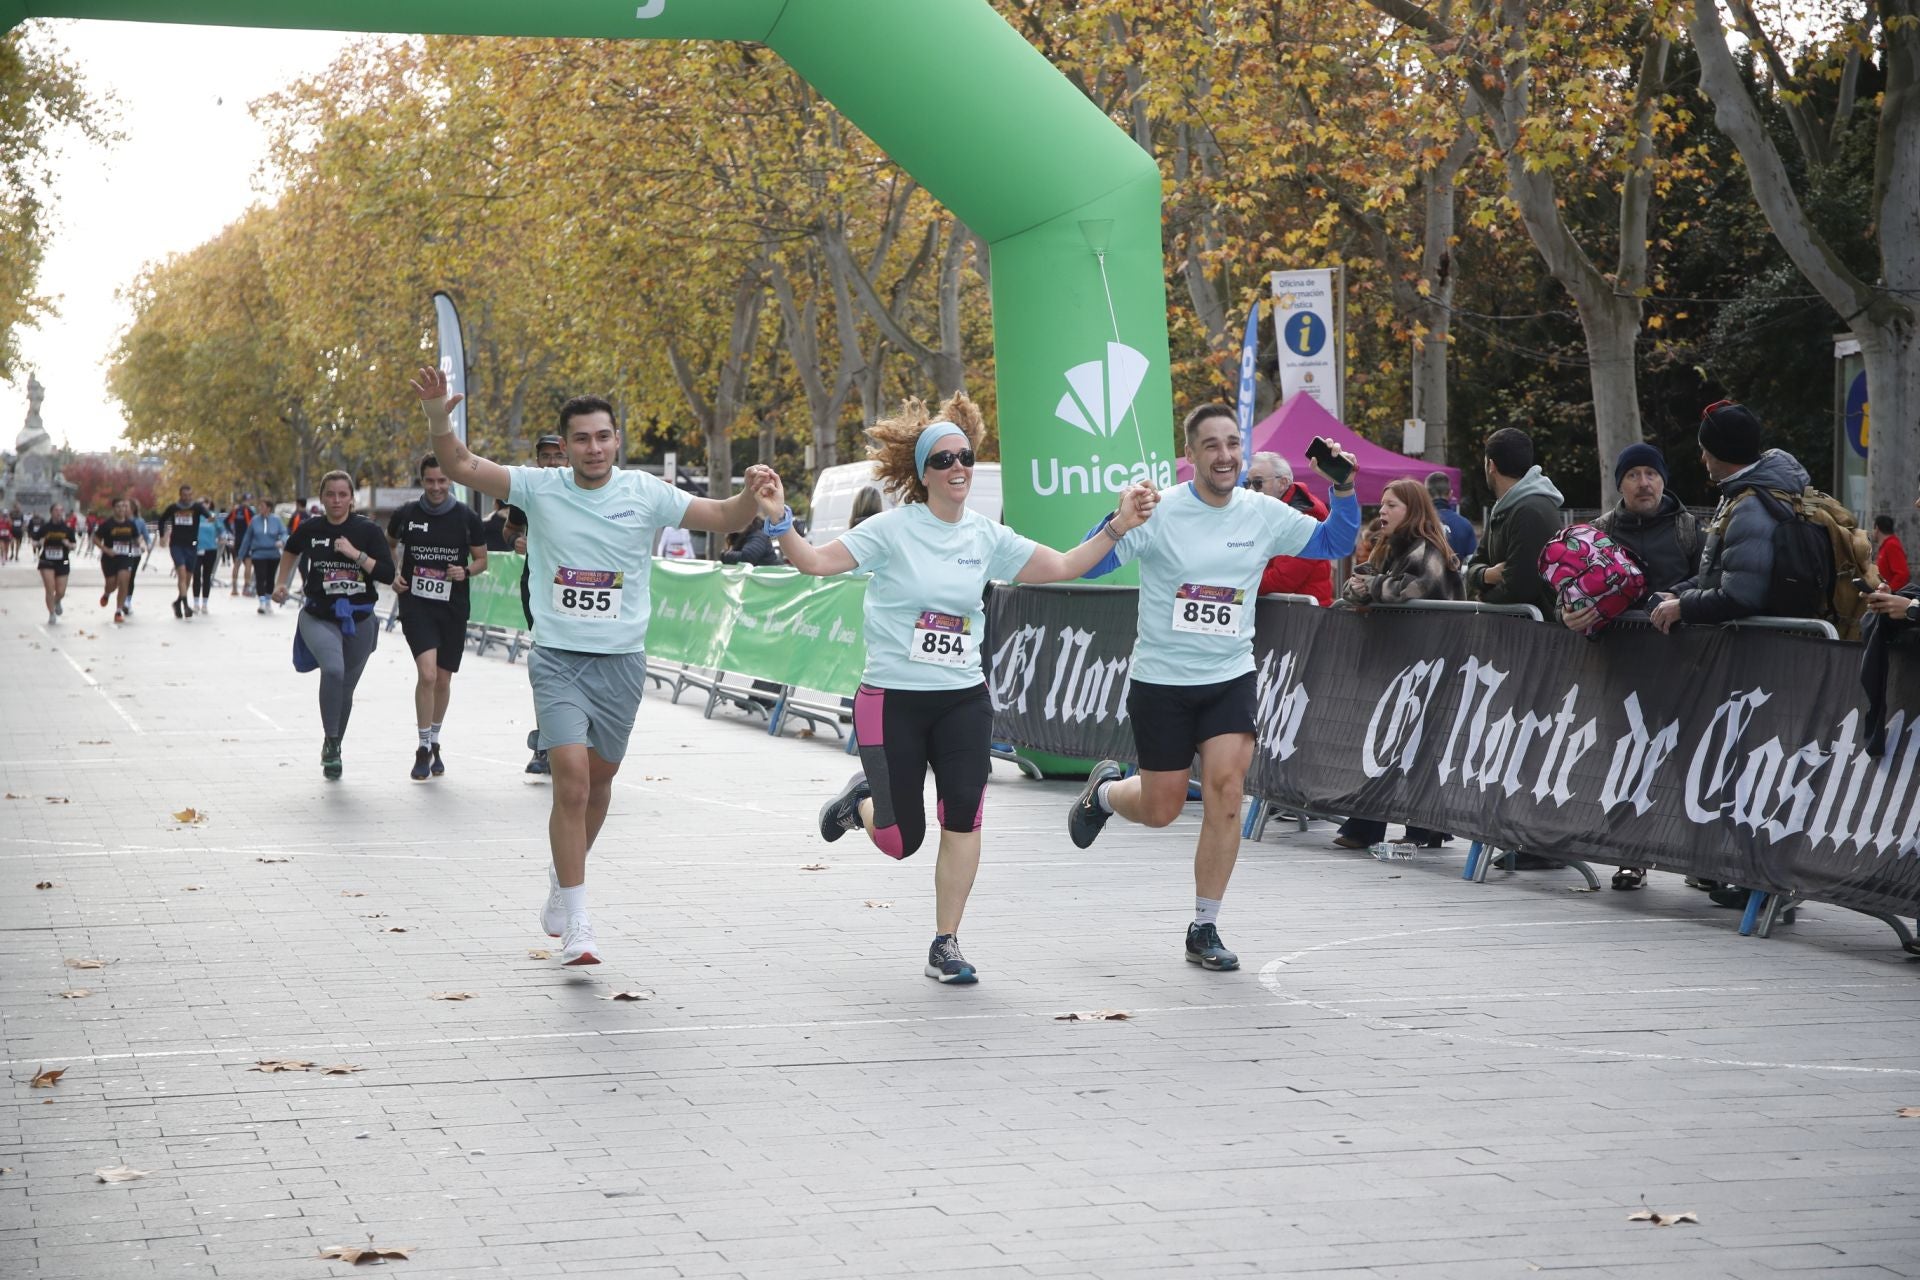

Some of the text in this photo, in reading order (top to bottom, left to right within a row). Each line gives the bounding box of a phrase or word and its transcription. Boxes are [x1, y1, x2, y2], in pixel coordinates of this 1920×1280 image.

[1031, 451, 1172, 497] Unicaja
[416, 578, 445, 594] 508
[562, 589, 610, 611] 855
[1184, 602, 1231, 625] 856
[922, 633, 963, 655] 854
[1438, 655, 1598, 809] Norte
[1598, 690, 1680, 818] de
[1684, 685, 1920, 860] Castill
